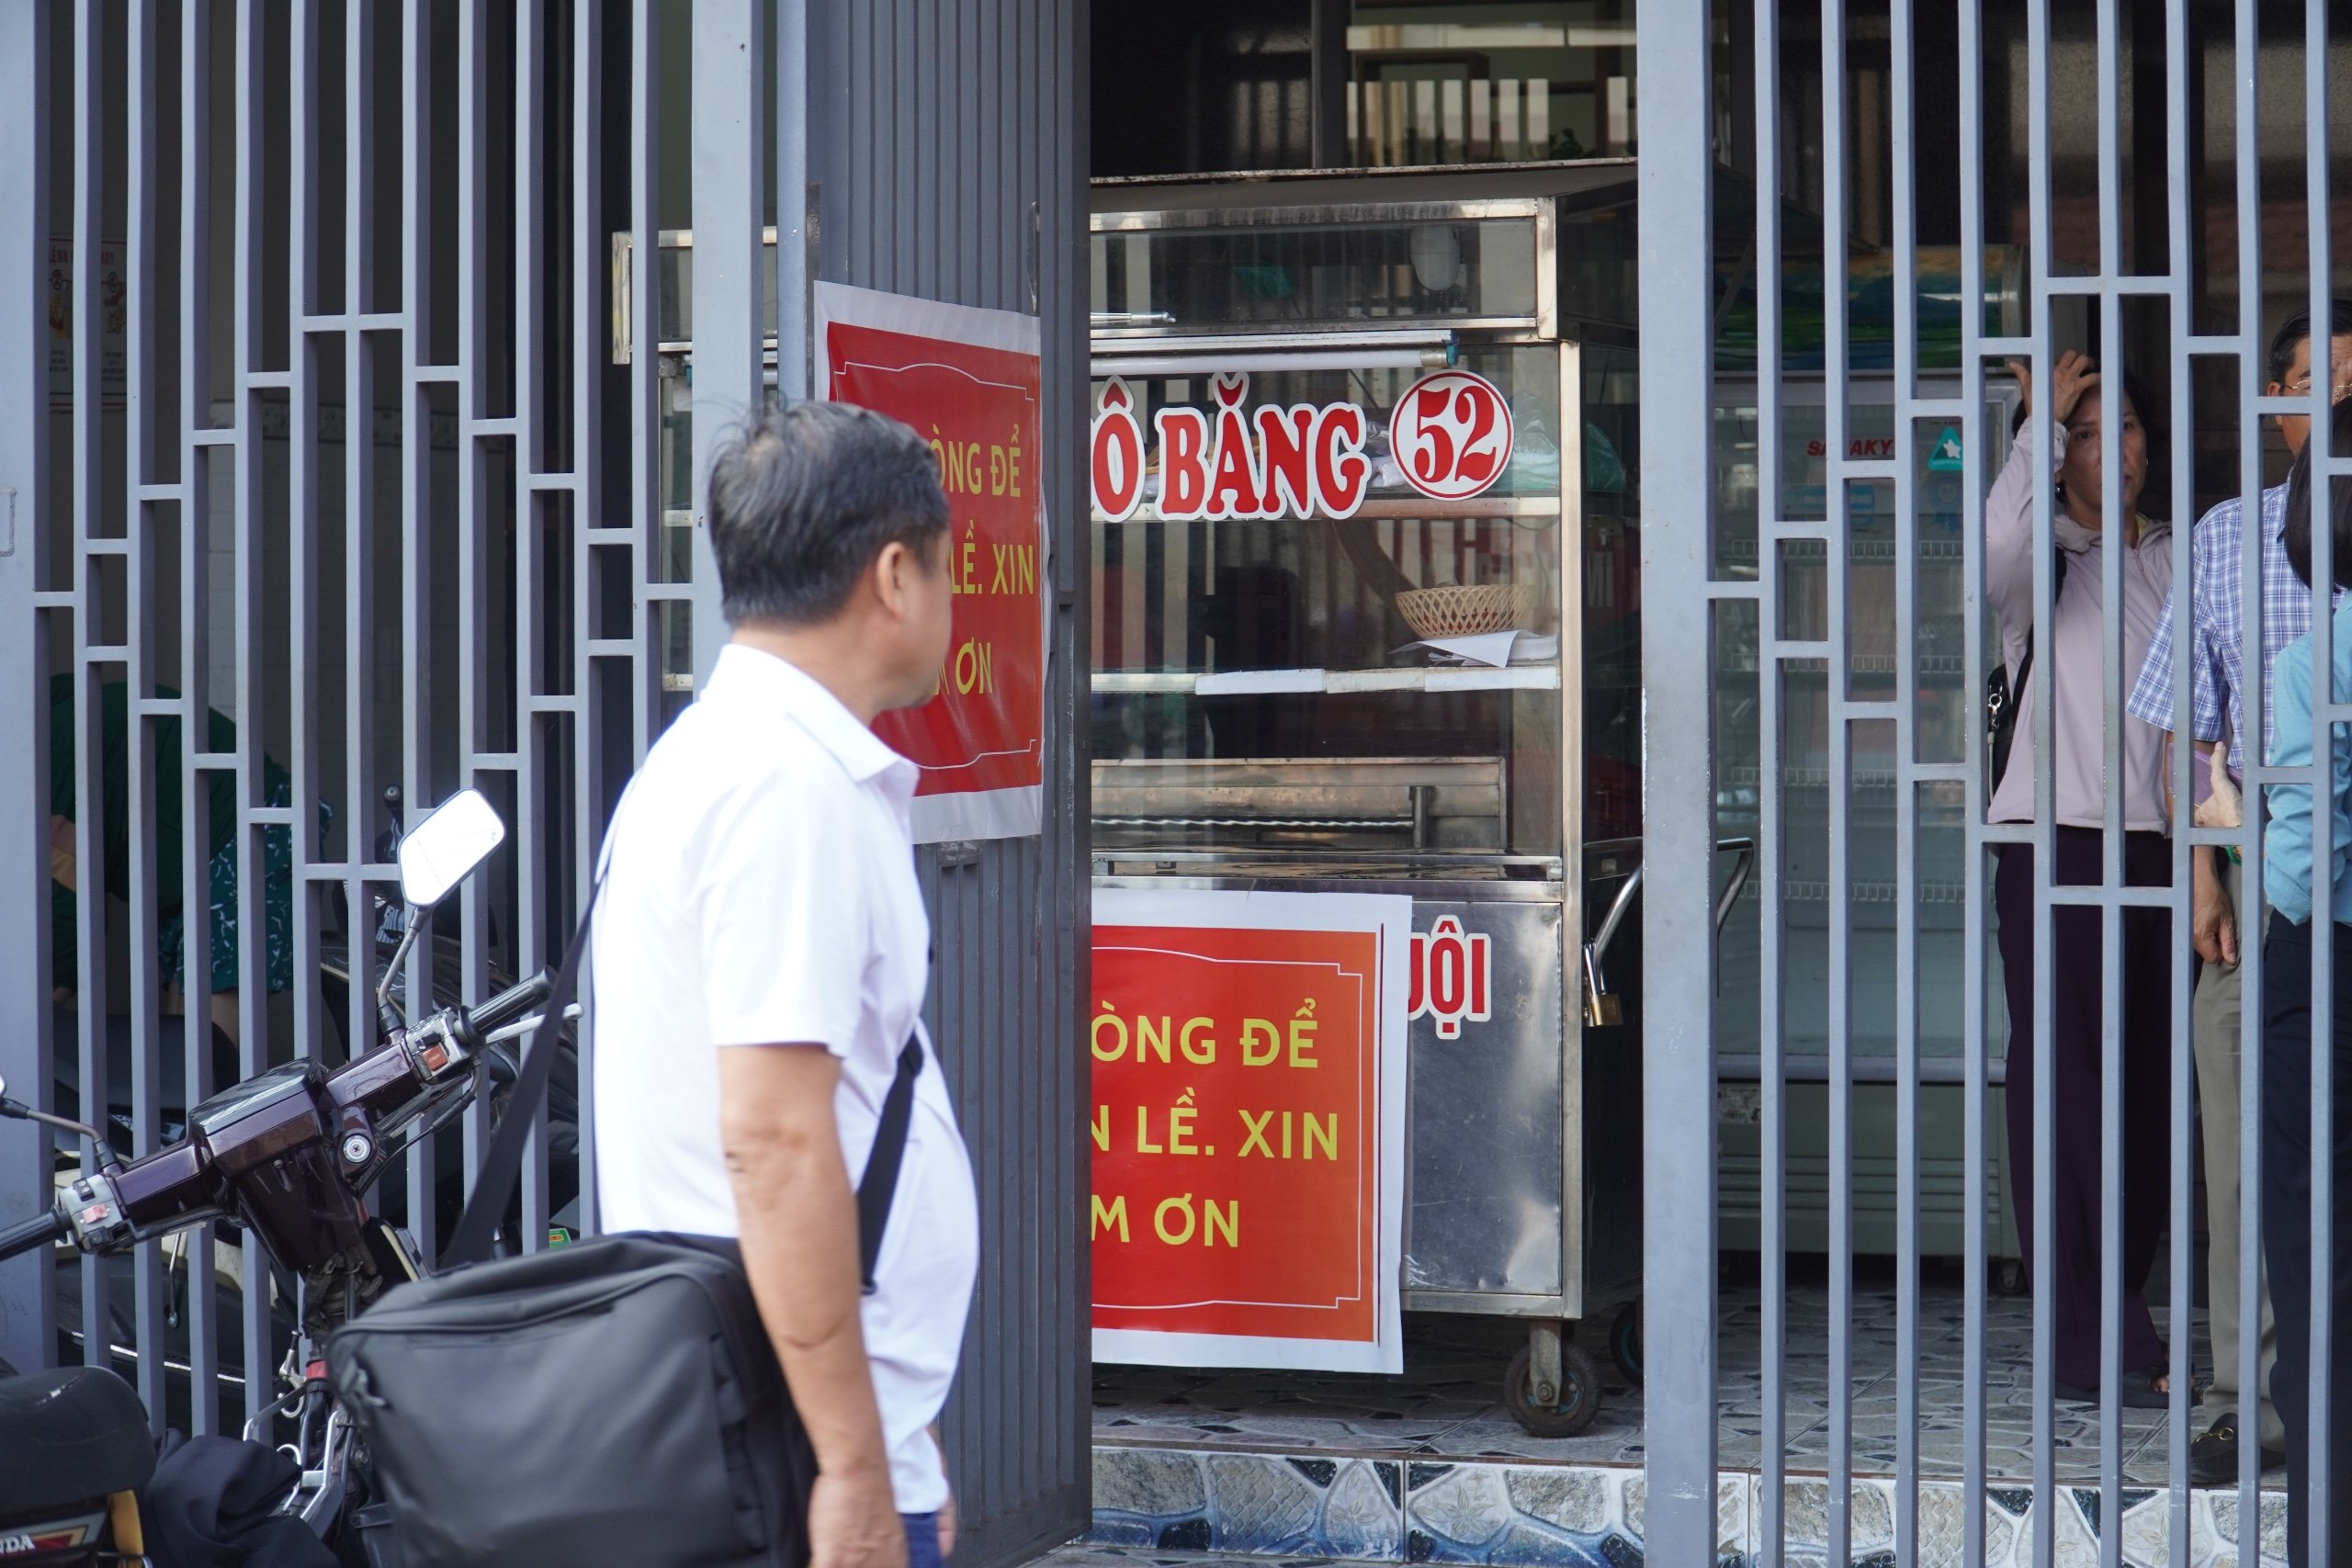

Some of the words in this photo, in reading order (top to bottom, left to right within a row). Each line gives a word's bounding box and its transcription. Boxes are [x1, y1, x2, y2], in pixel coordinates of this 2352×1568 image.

[930, 423, 982, 495] ÒNG
[990, 423, 1022, 498] ĐỂ
[1091, 378, 1143, 518] Ô
[1158, 375, 1368, 516] BĂNG
[1414, 384, 1498, 483] 52
[1806, 439, 1895, 457] SAAKY
[949, 520, 983, 594] LỀ.
[991, 544, 1034, 595] XIN
[956, 636, 993, 695] ƠN
[1091, 1000, 1216, 1064] ÒNG
[1238, 998, 1318, 1068] ĐỂ
[1137, 1088, 1215, 1156] LỀ.
[1238, 1109, 1338, 1161] XIN
[1154, 1192, 1238, 1248] ƠN
[0, 1534, 36, 1554] DA
